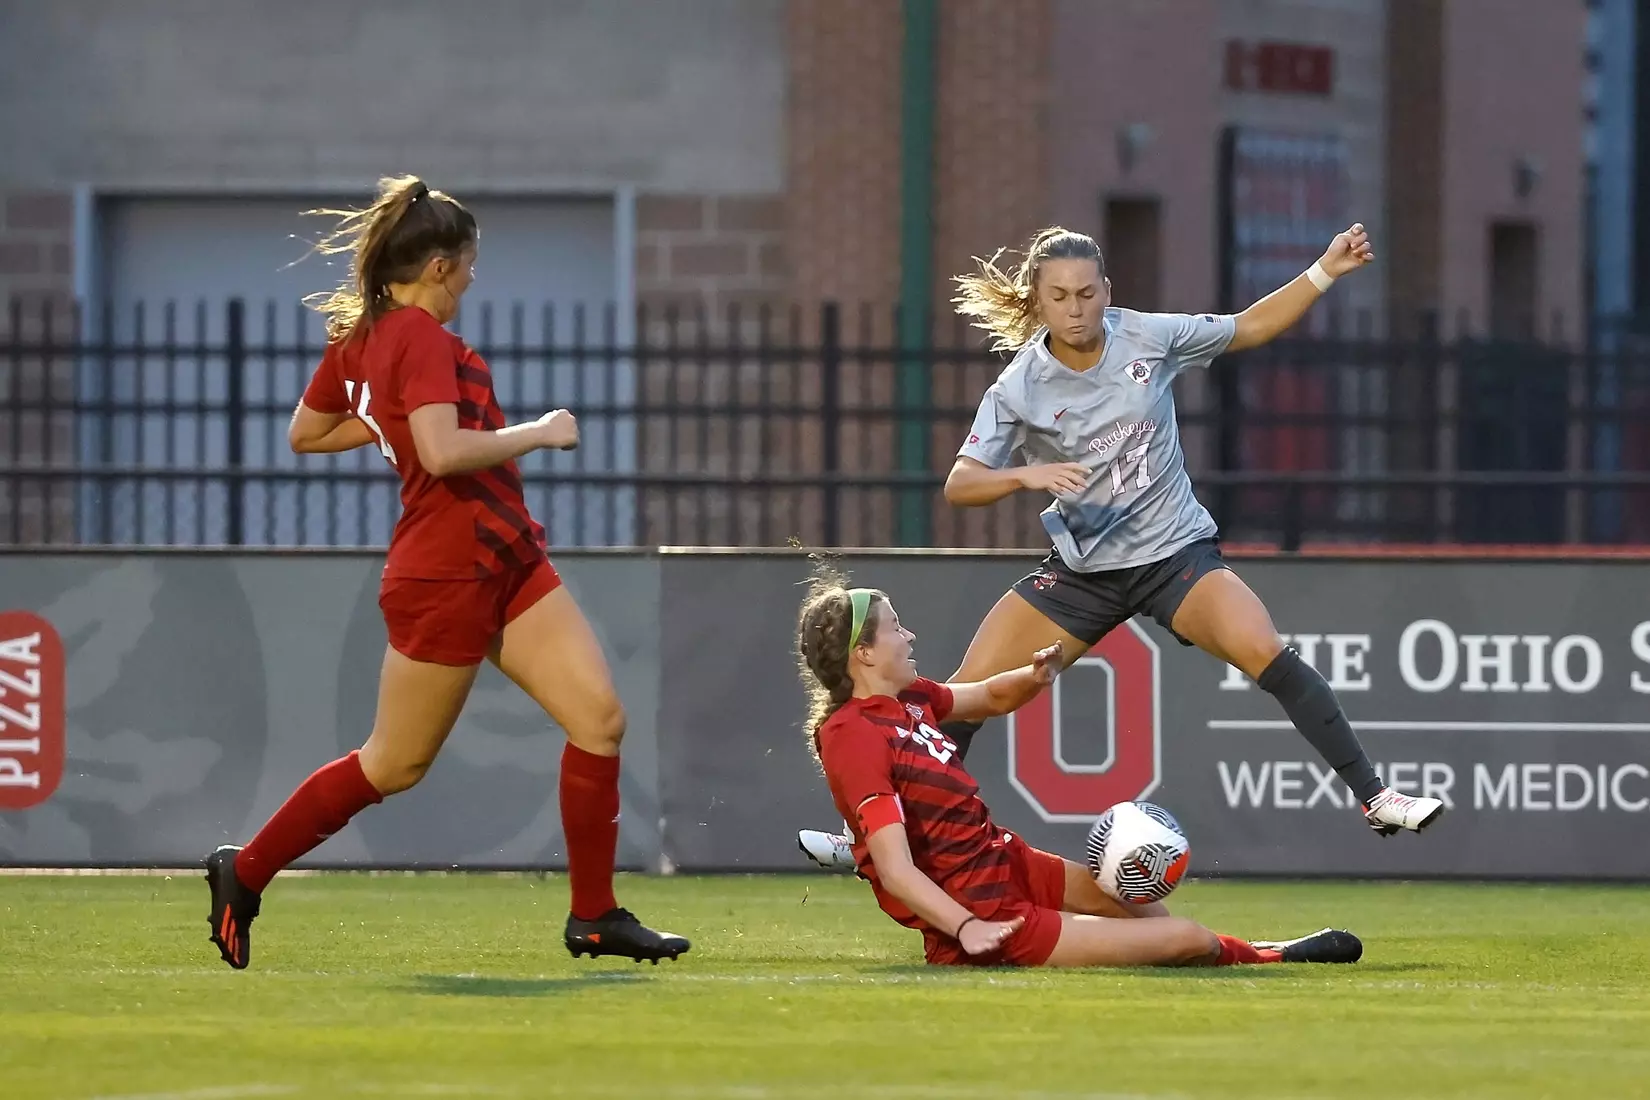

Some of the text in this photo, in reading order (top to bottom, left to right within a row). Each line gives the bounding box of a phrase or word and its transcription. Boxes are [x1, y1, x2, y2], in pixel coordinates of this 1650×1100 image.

[1088, 418, 1157, 458] Buckeyes
[1109, 442, 1152, 497] 17
[1399, 619, 1603, 693] OHIO
[0, 632, 41, 789] PIZZA
[1217, 761, 1650, 812] WEXER MEDIC
